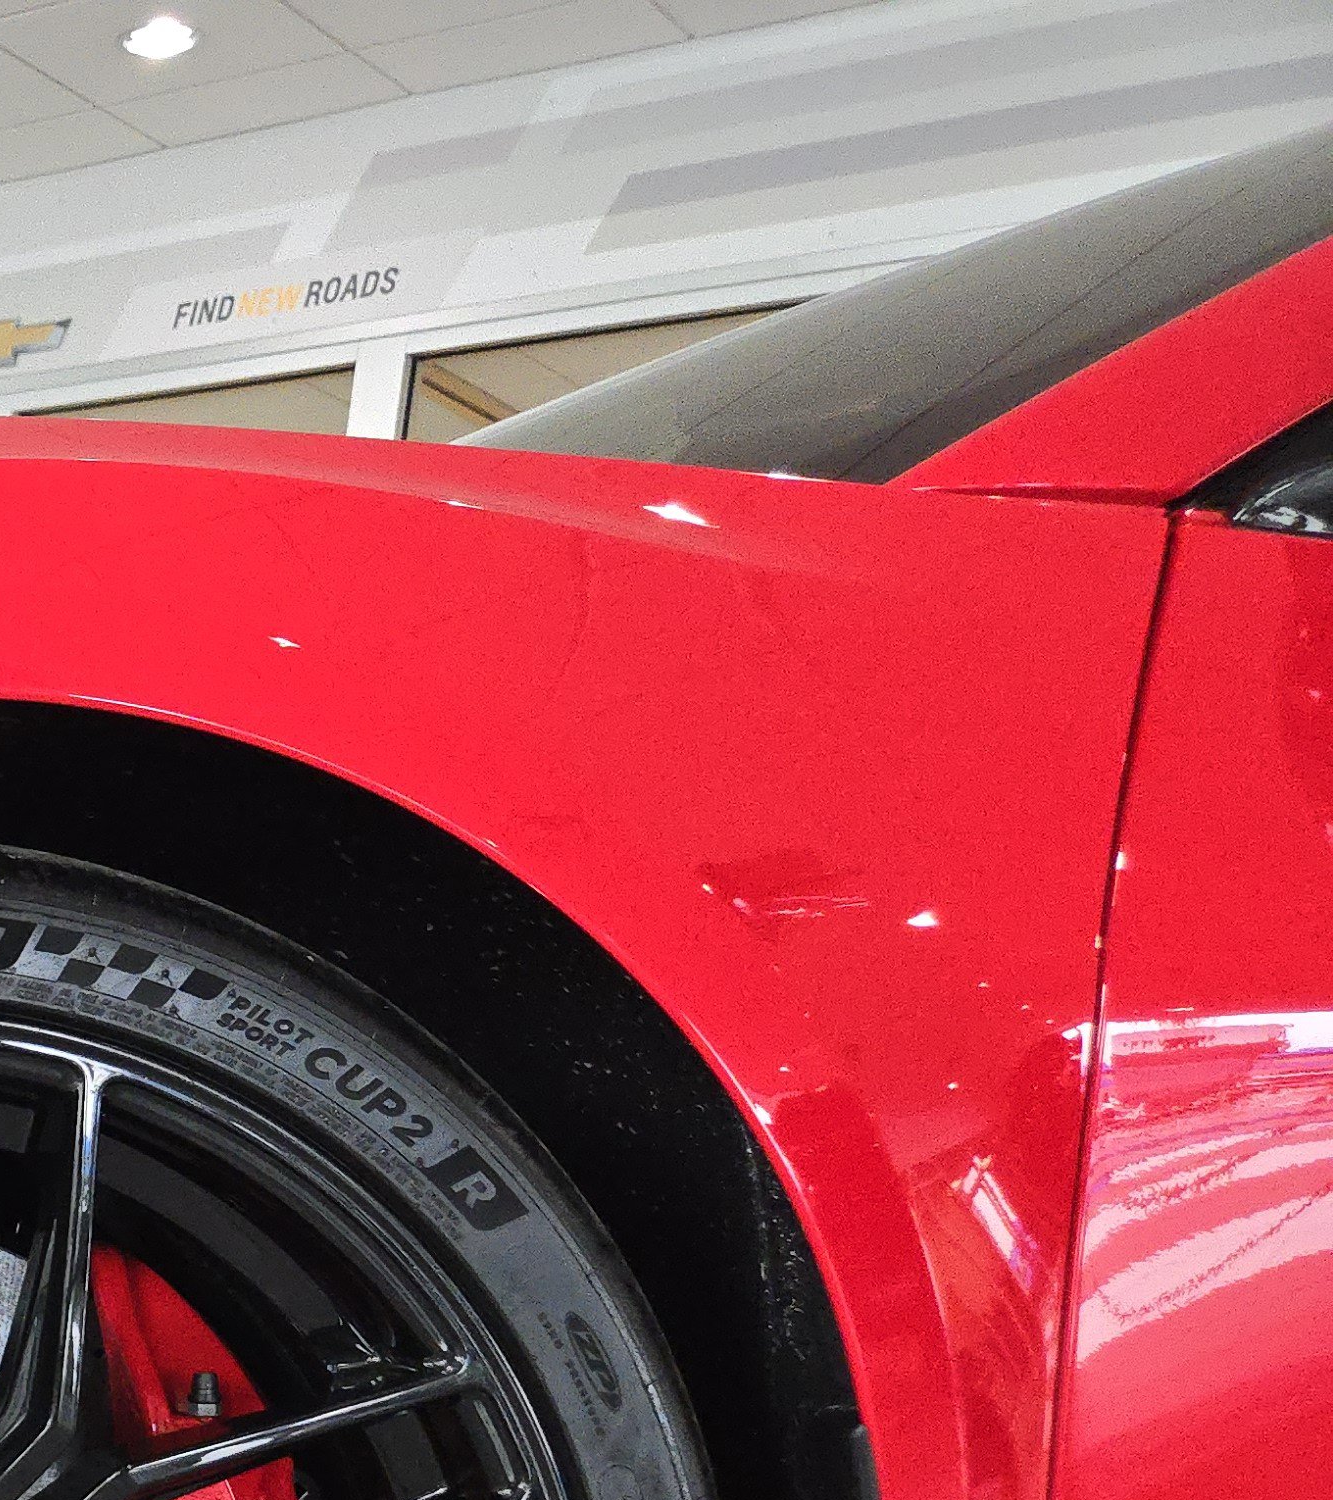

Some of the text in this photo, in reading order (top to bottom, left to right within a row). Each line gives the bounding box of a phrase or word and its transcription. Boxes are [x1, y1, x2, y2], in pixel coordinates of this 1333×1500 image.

[304, 266, 400, 308] ROADS
[216, 1011, 297, 1058] SPORT
[228, 994, 315, 1047] PILOT
[450, 1171, 499, 1209] R
